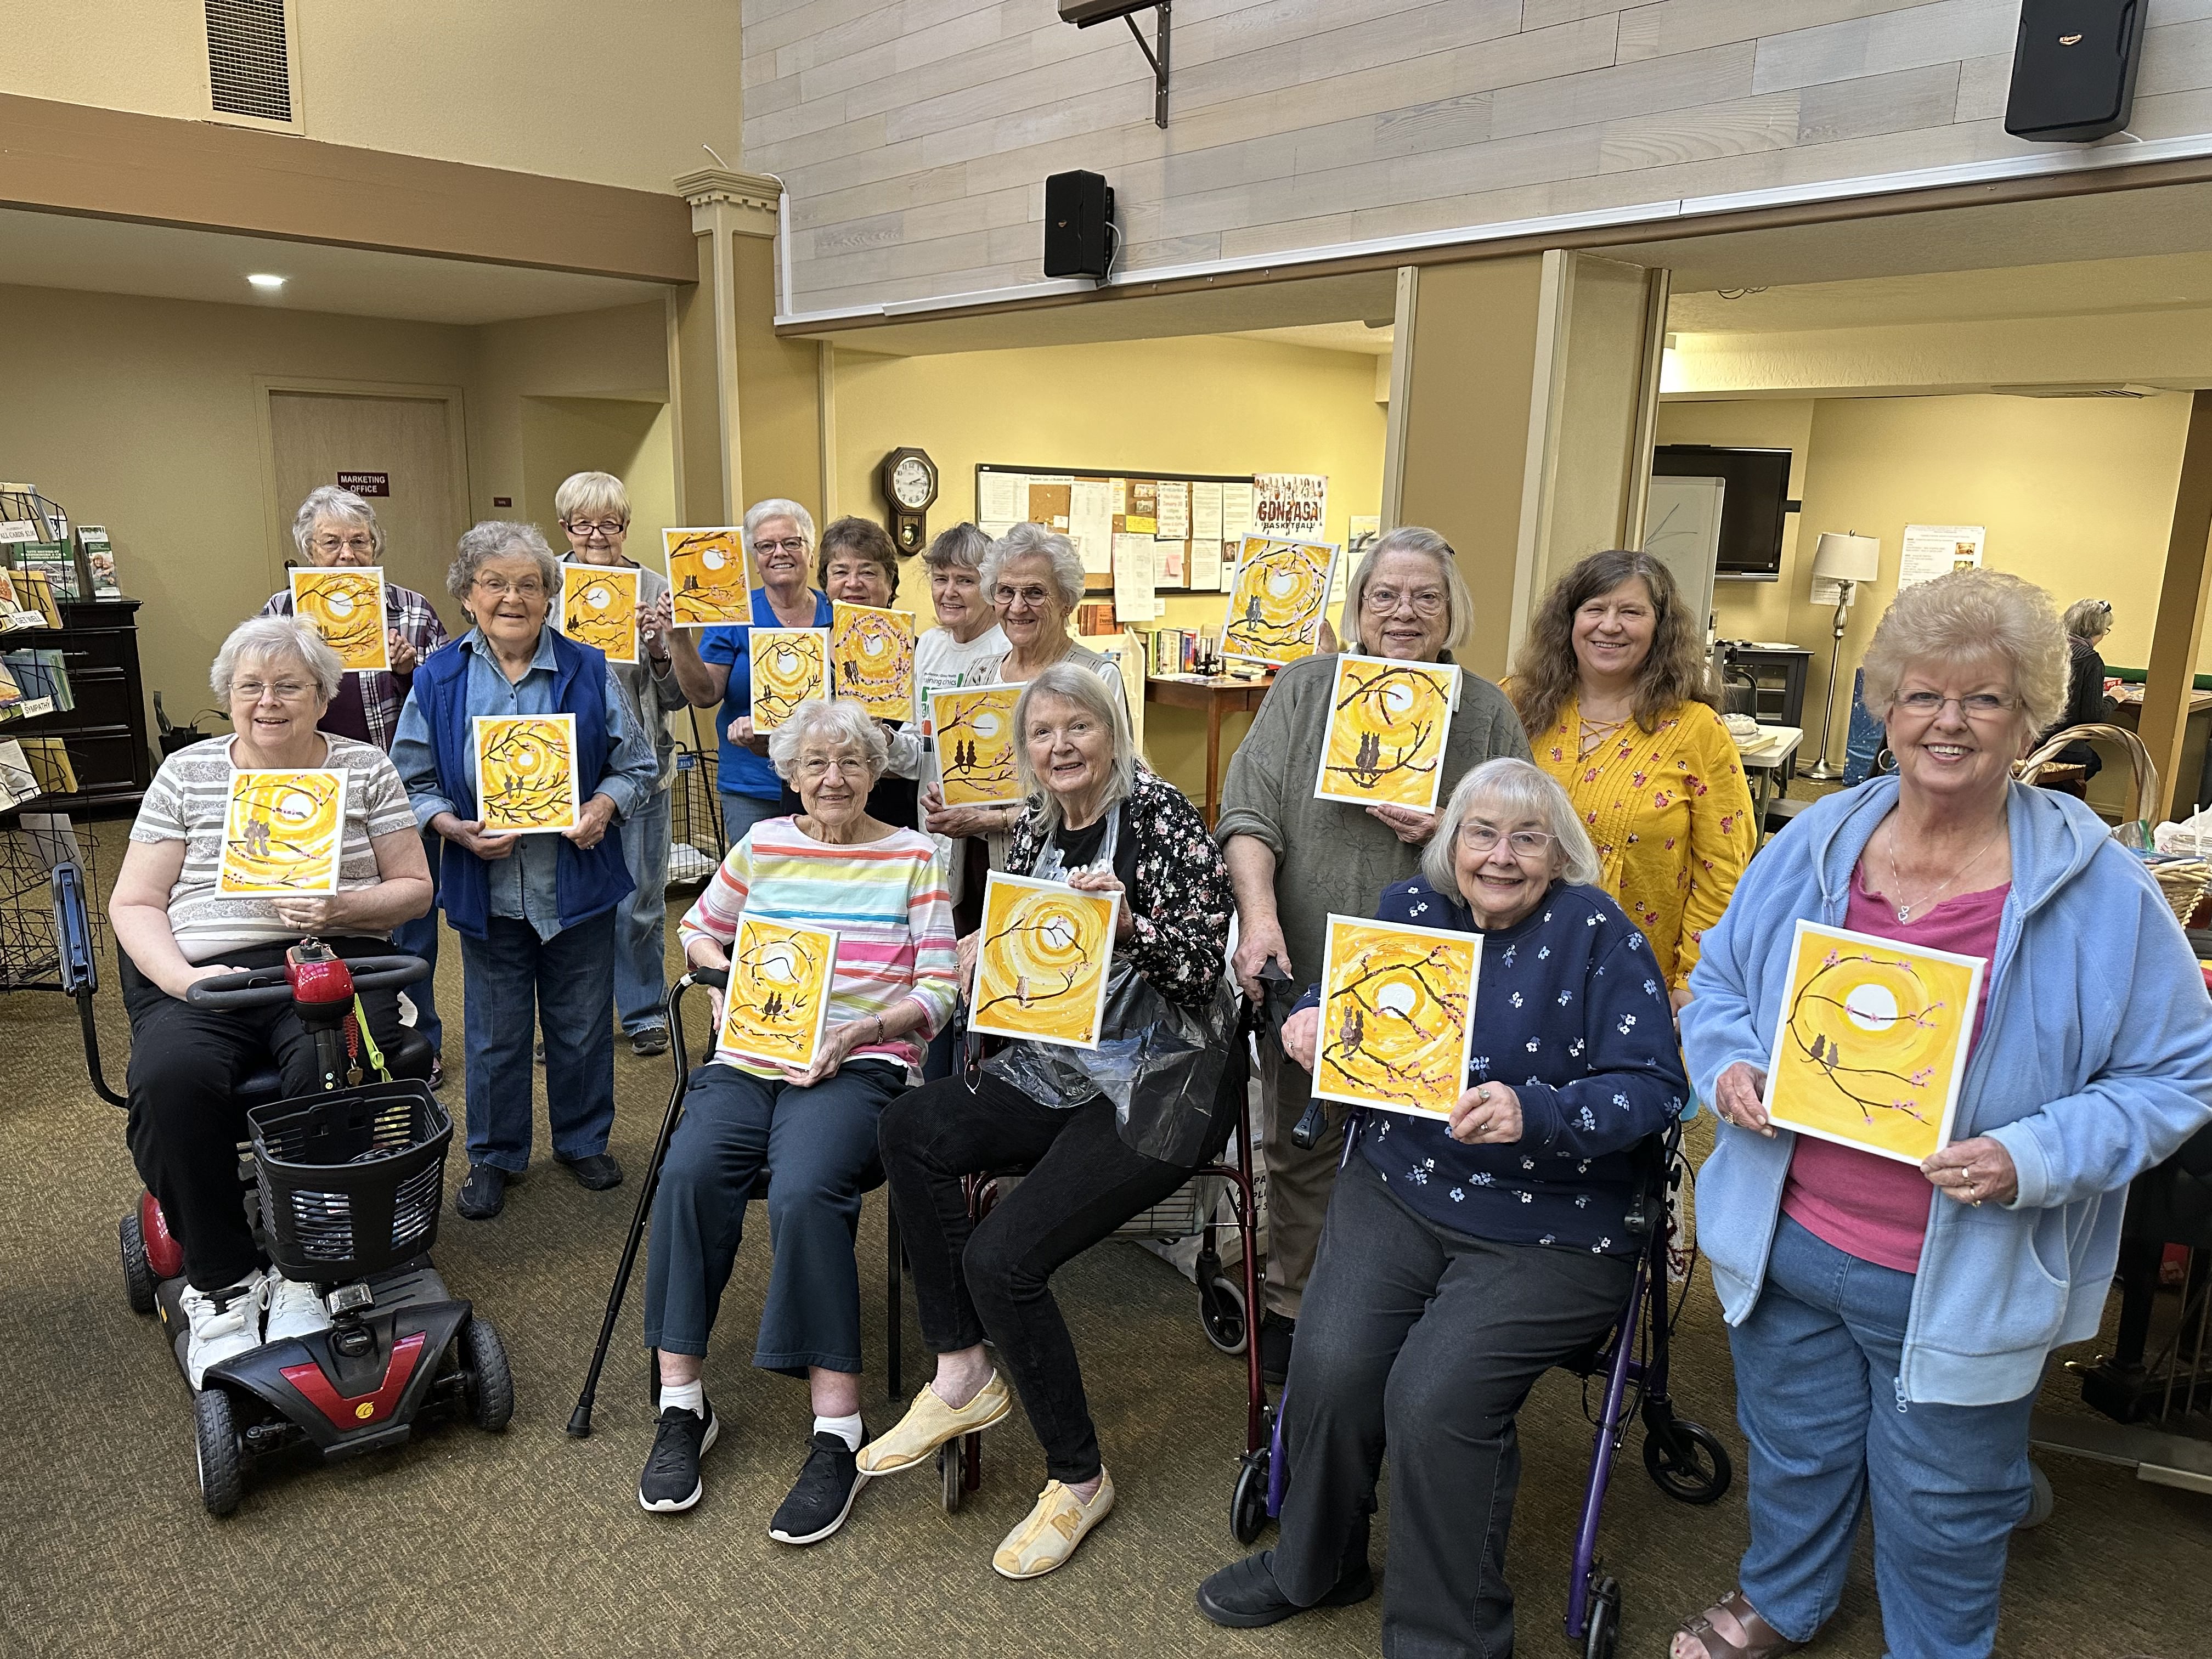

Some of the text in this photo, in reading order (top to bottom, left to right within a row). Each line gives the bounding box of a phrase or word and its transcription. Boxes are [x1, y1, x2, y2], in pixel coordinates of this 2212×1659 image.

[341, 475, 386, 484] MARKETING
[350, 484, 377, 493] OFFICE
[1259, 500, 1318, 521] GONZAGA
[27, 614, 43, 623] WELL
[24, 701, 50, 714] SYMPATHY
